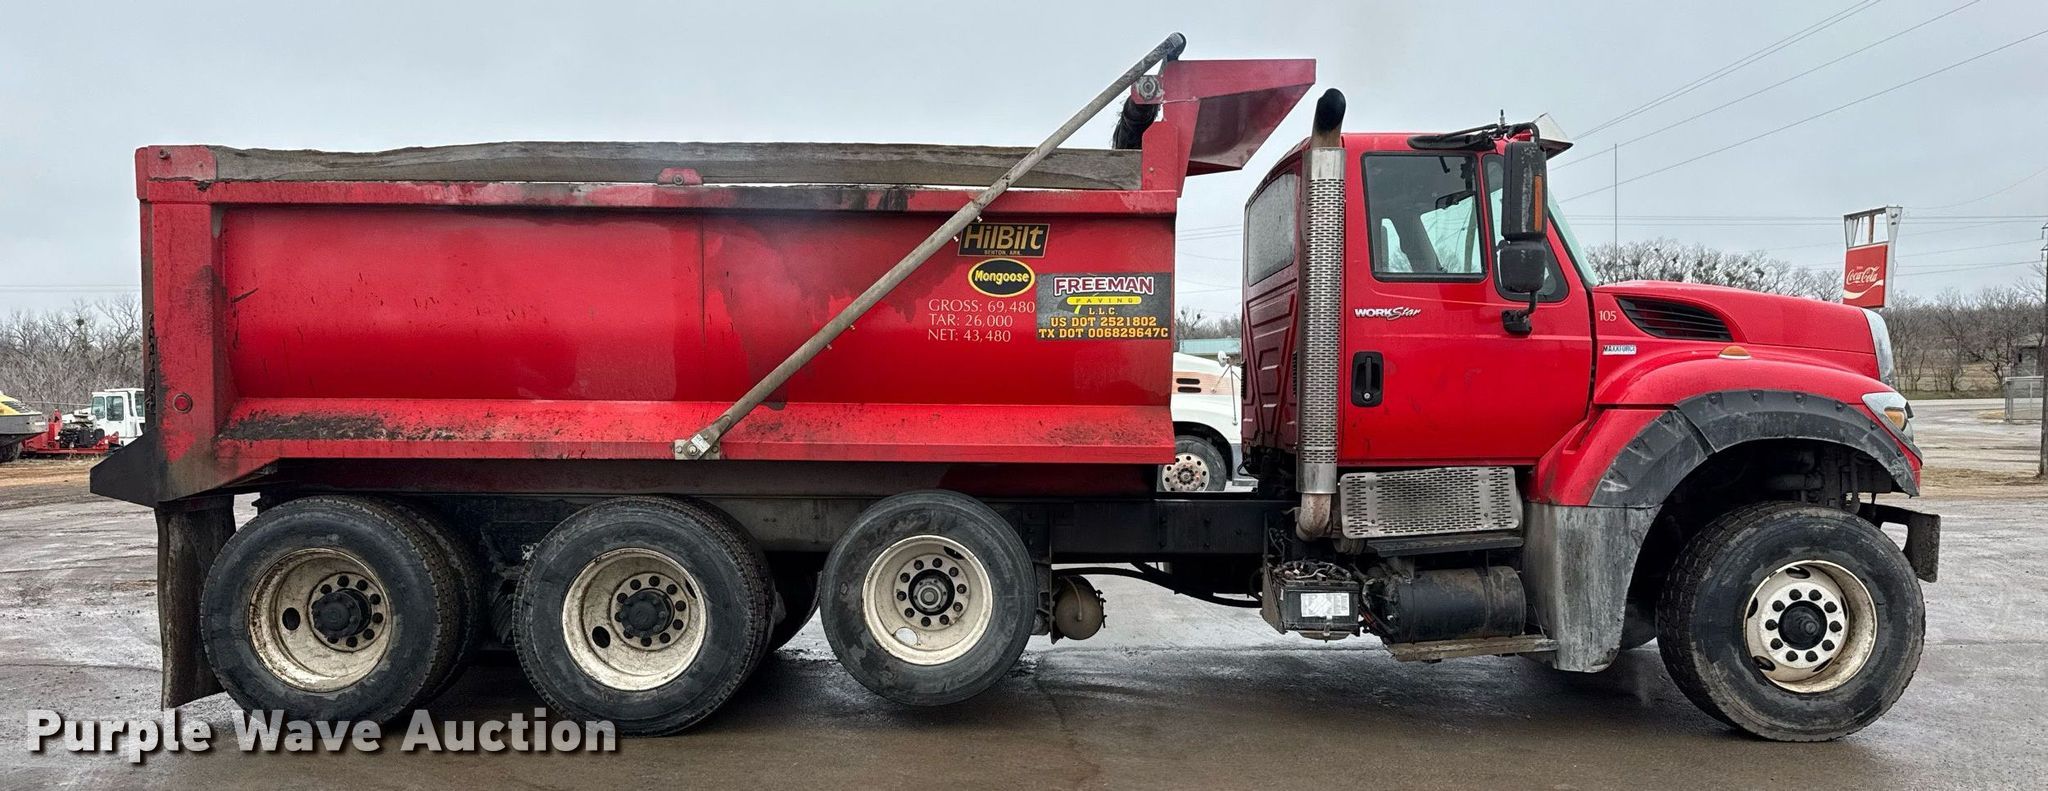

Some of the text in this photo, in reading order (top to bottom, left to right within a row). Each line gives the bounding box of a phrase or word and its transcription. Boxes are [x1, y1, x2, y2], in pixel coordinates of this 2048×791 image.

[963, 225, 1044, 250] HilBilt
[974, 270, 1030, 285] Mongoose
[1054, 276, 1154, 296] FREEMAN
[928, 298, 1036, 313] GROSS: 69,480
[1088, 307, 1119, 315] L.L.C.
[928, 313, 1013, 328] TAR: 26,000
[1050, 317, 1157, 327] US DOT 2521802
[1598, 310, 1617, 322] 105
[927, 328, 1012, 343] NET: 43,480
[1039, 328, 1168, 338] TX DOT 006829647C
